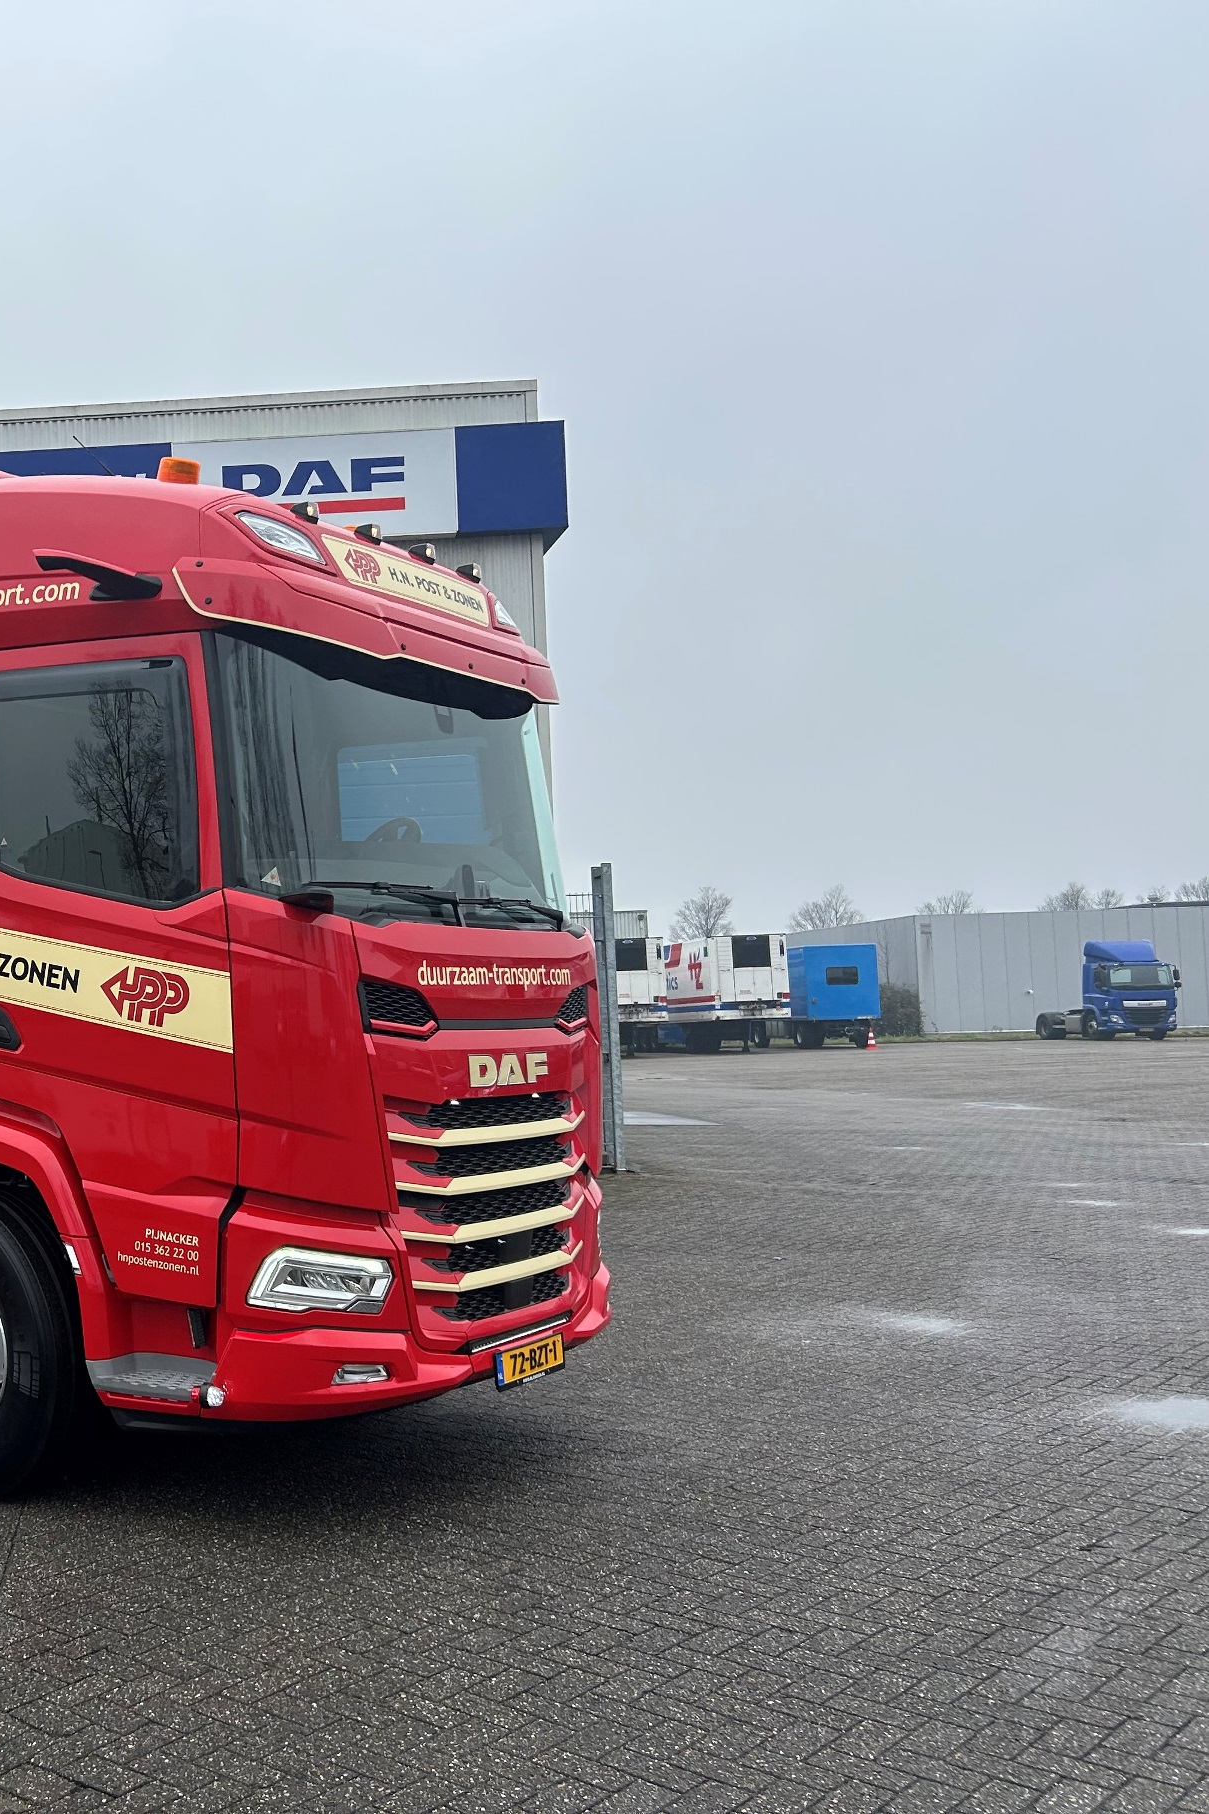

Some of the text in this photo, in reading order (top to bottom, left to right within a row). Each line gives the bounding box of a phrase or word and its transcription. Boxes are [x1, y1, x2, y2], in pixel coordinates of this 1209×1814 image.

[222, 456, 405, 497] DAF
[388, 566, 484, 614] H.N. POST & ZONEN
[417, 959, 571, 991] duurzaam-transport.com
[467, 1051, 549, 1088] DAF
[134, 1240, 199, 1262] 015 362 22 00
[145, 1228, 199, 1247] PIJNACKER
[117, 1250, 200, 1276] hnpostenzonen.nl
[510, 1340, 557, 1377] 72-BZT-1
